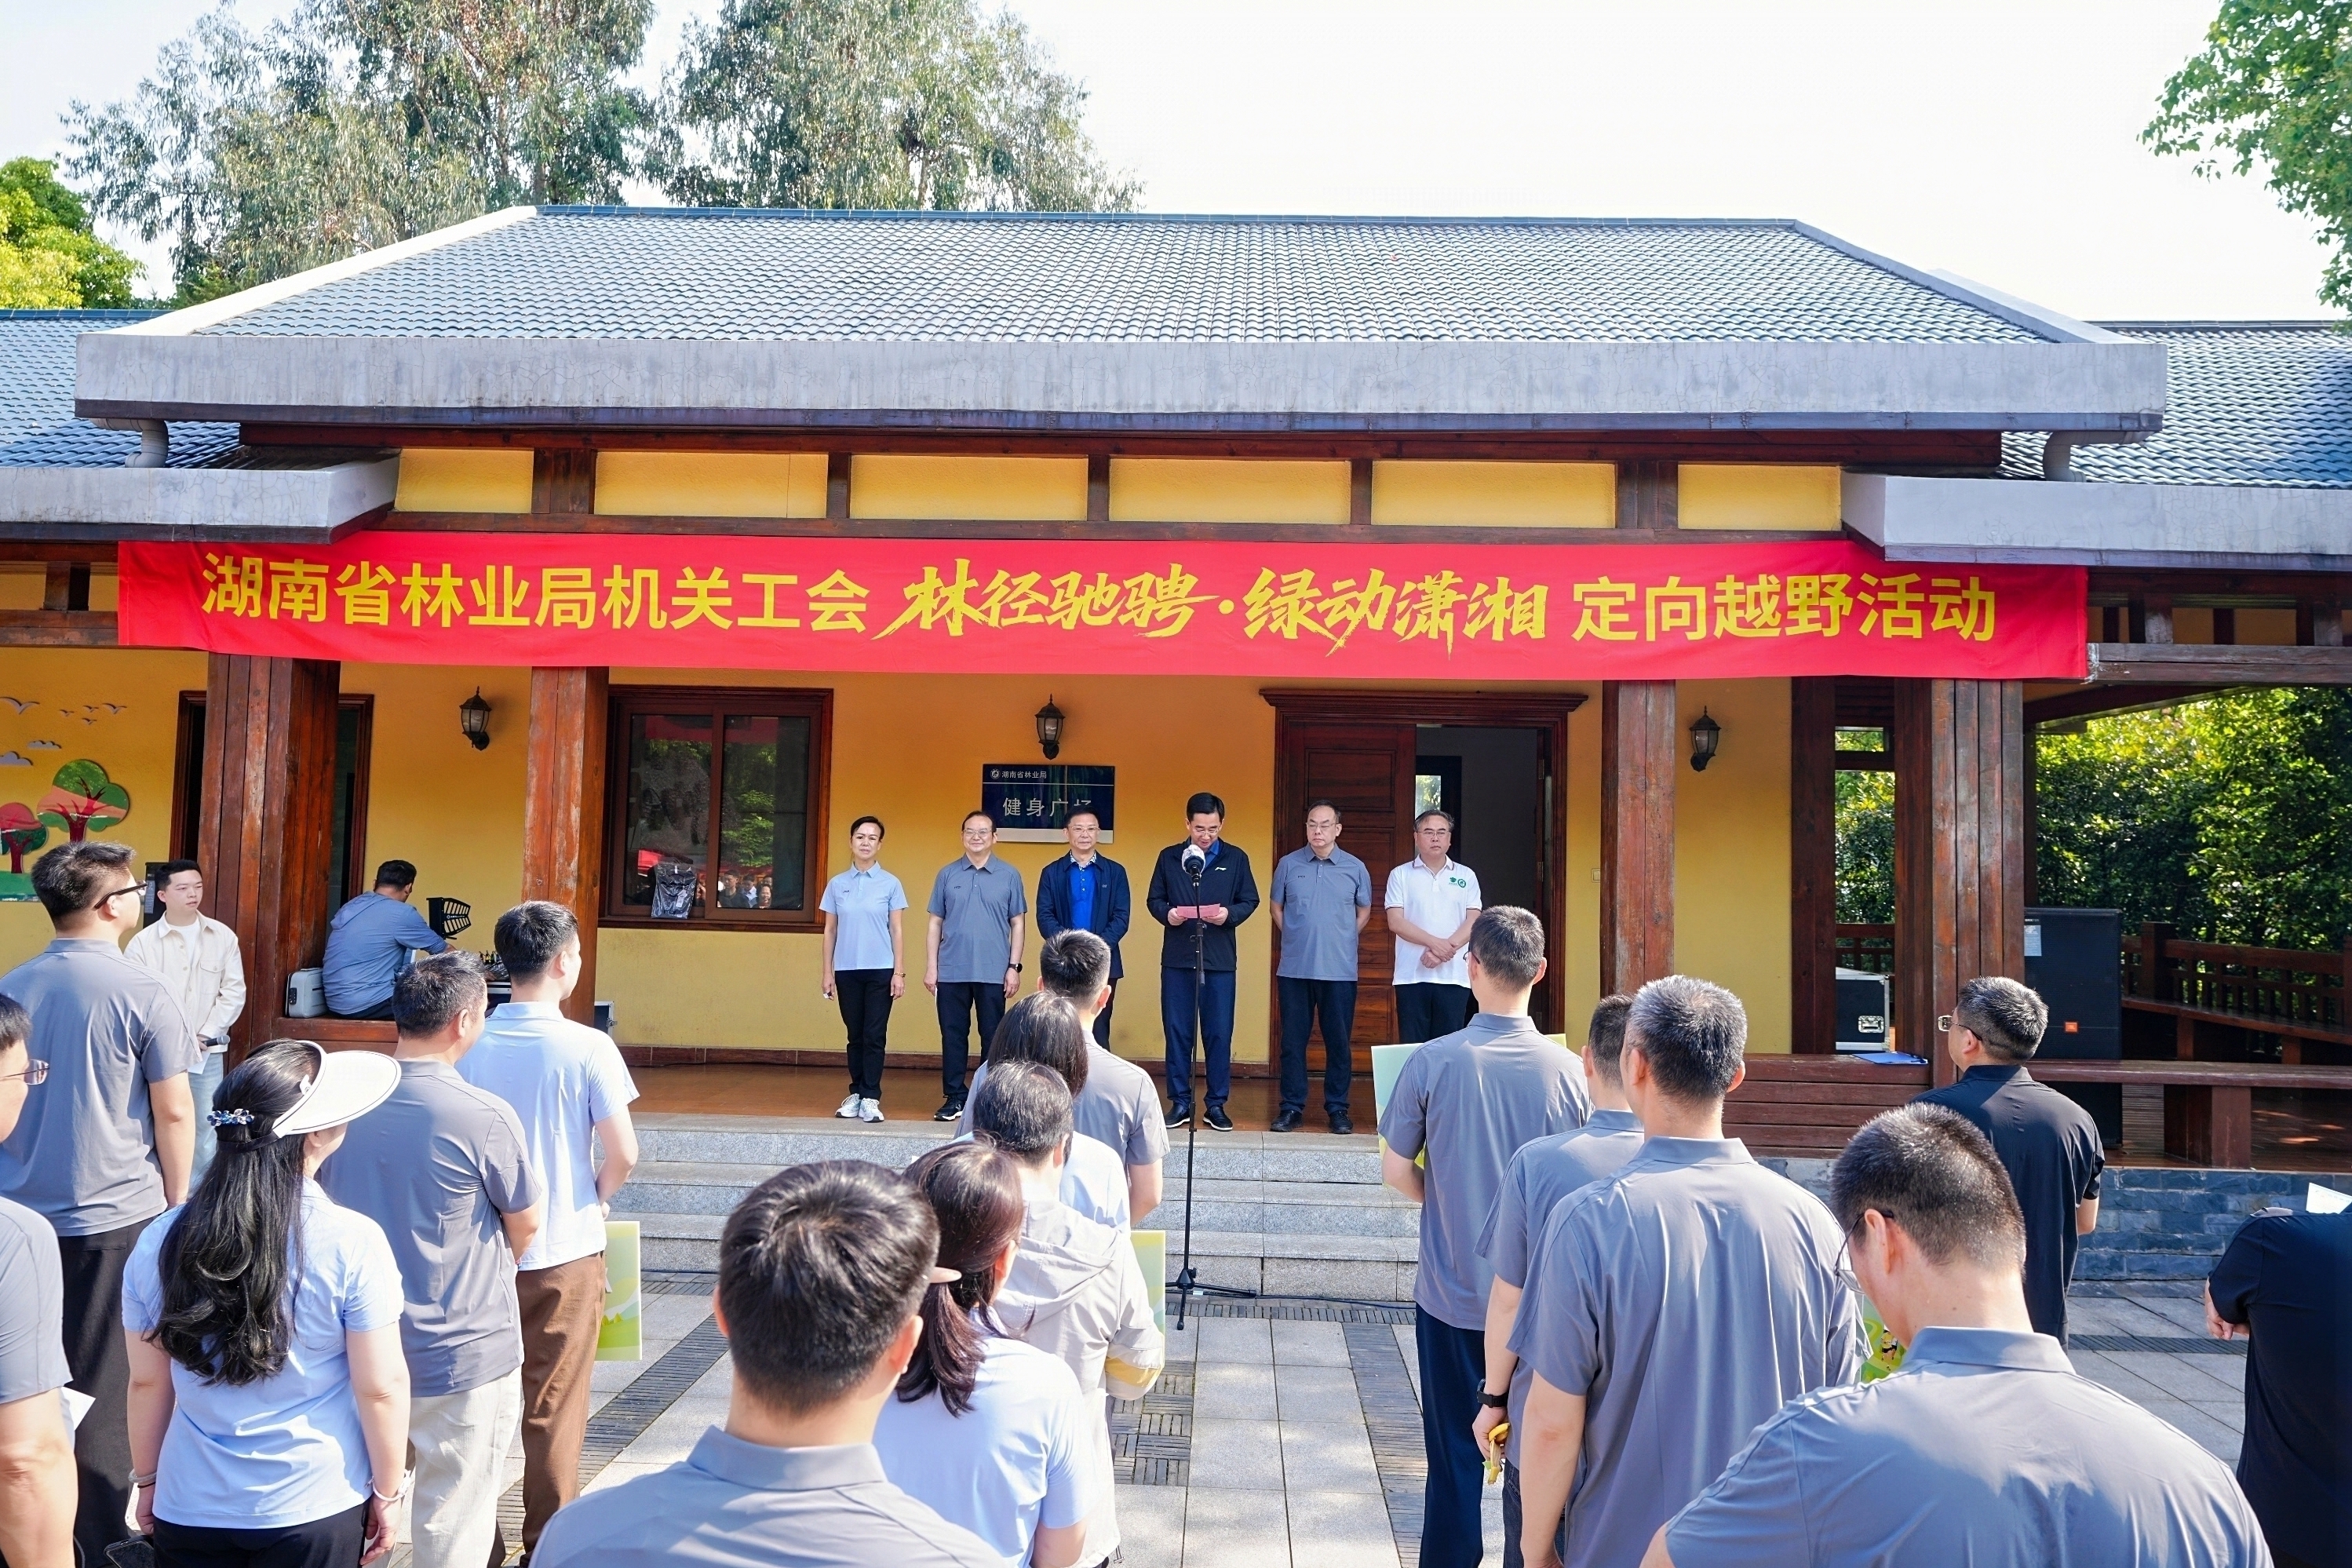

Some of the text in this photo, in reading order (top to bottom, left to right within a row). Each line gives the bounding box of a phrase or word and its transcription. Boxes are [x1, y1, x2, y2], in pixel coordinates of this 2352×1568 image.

[201, 552, 871, 634] 湖南省林业局机关工会
[1571, 572, 1996, 642] 定向越野活动
[1001, 770, 1047, 779] 湖南省林业局
